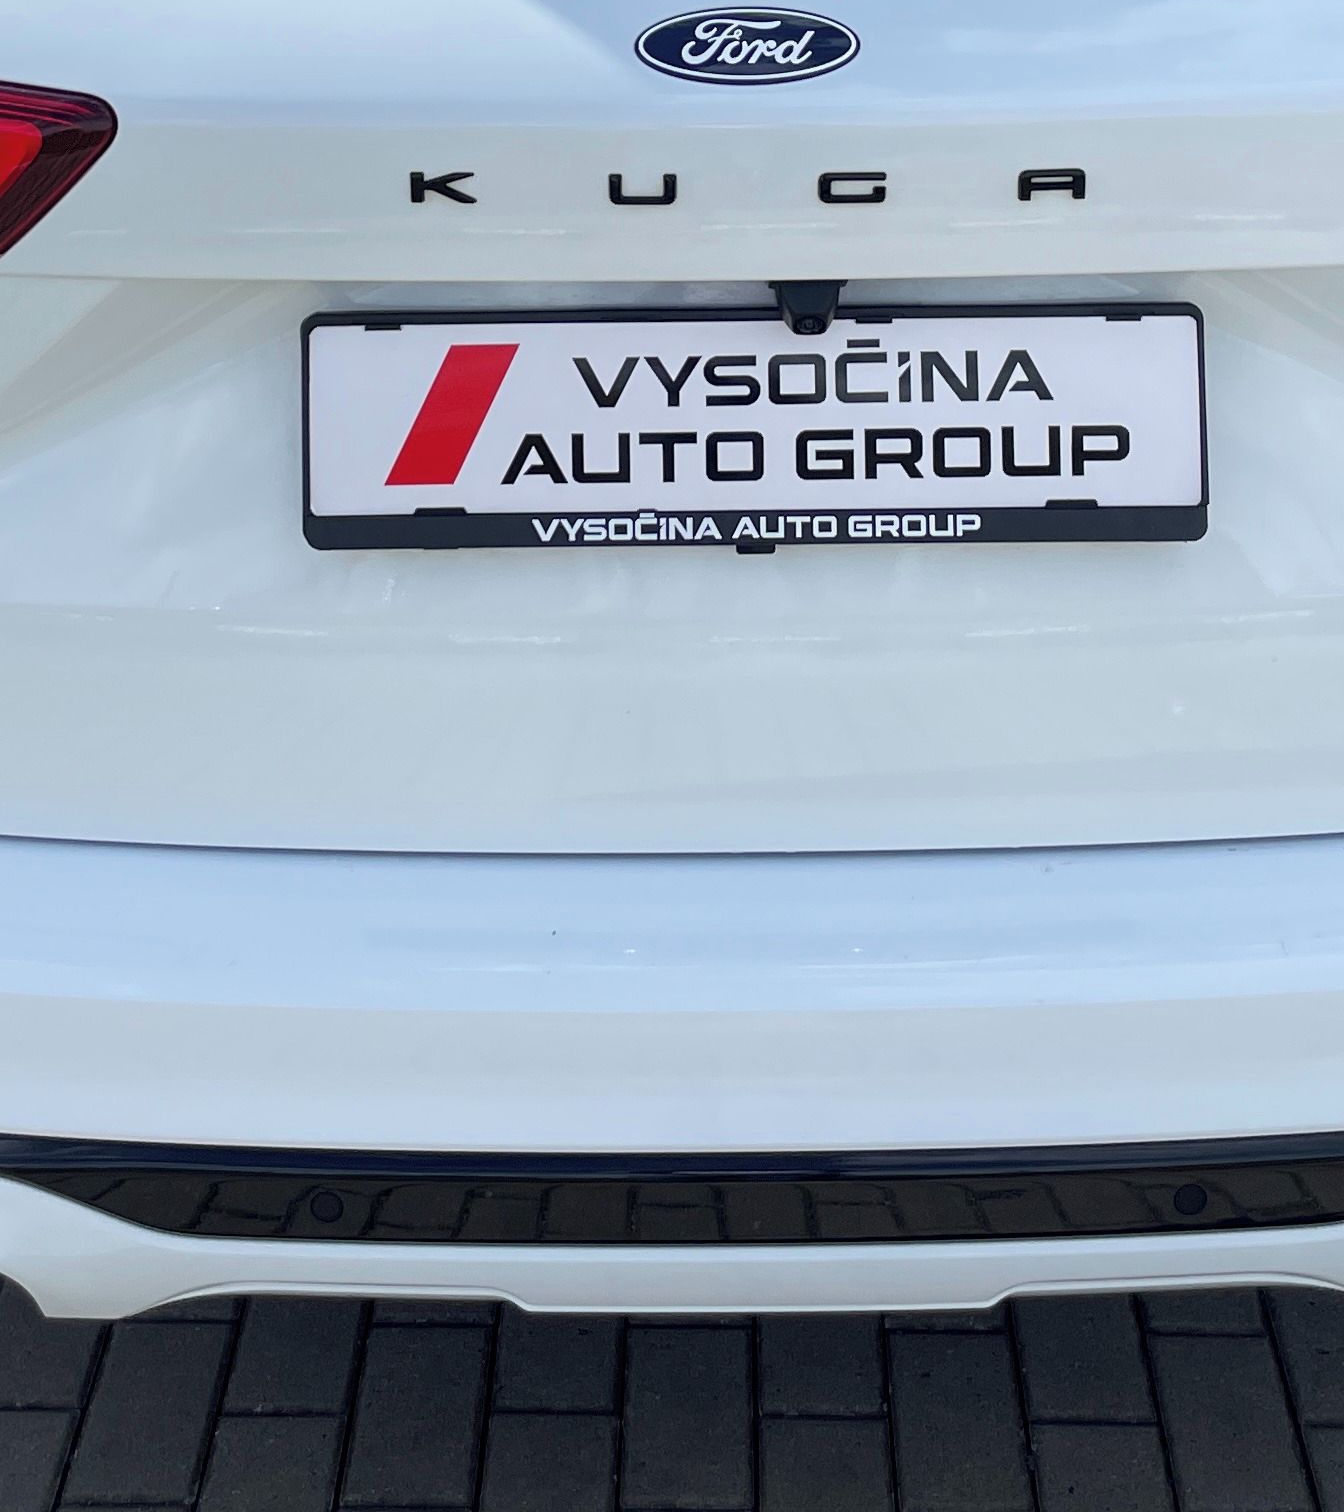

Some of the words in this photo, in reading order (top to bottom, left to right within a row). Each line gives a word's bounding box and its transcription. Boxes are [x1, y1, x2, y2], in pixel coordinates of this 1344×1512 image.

[680, 18, 814, 66] Ford
[409, 168, 1086, 206] KUGA
[500, 431, 765, 485] AUTO
[795, 425, 1130, 481] GROUP
[731, 515, 839, 540] AUTO
[847, 513, 982, 539] GROUP
